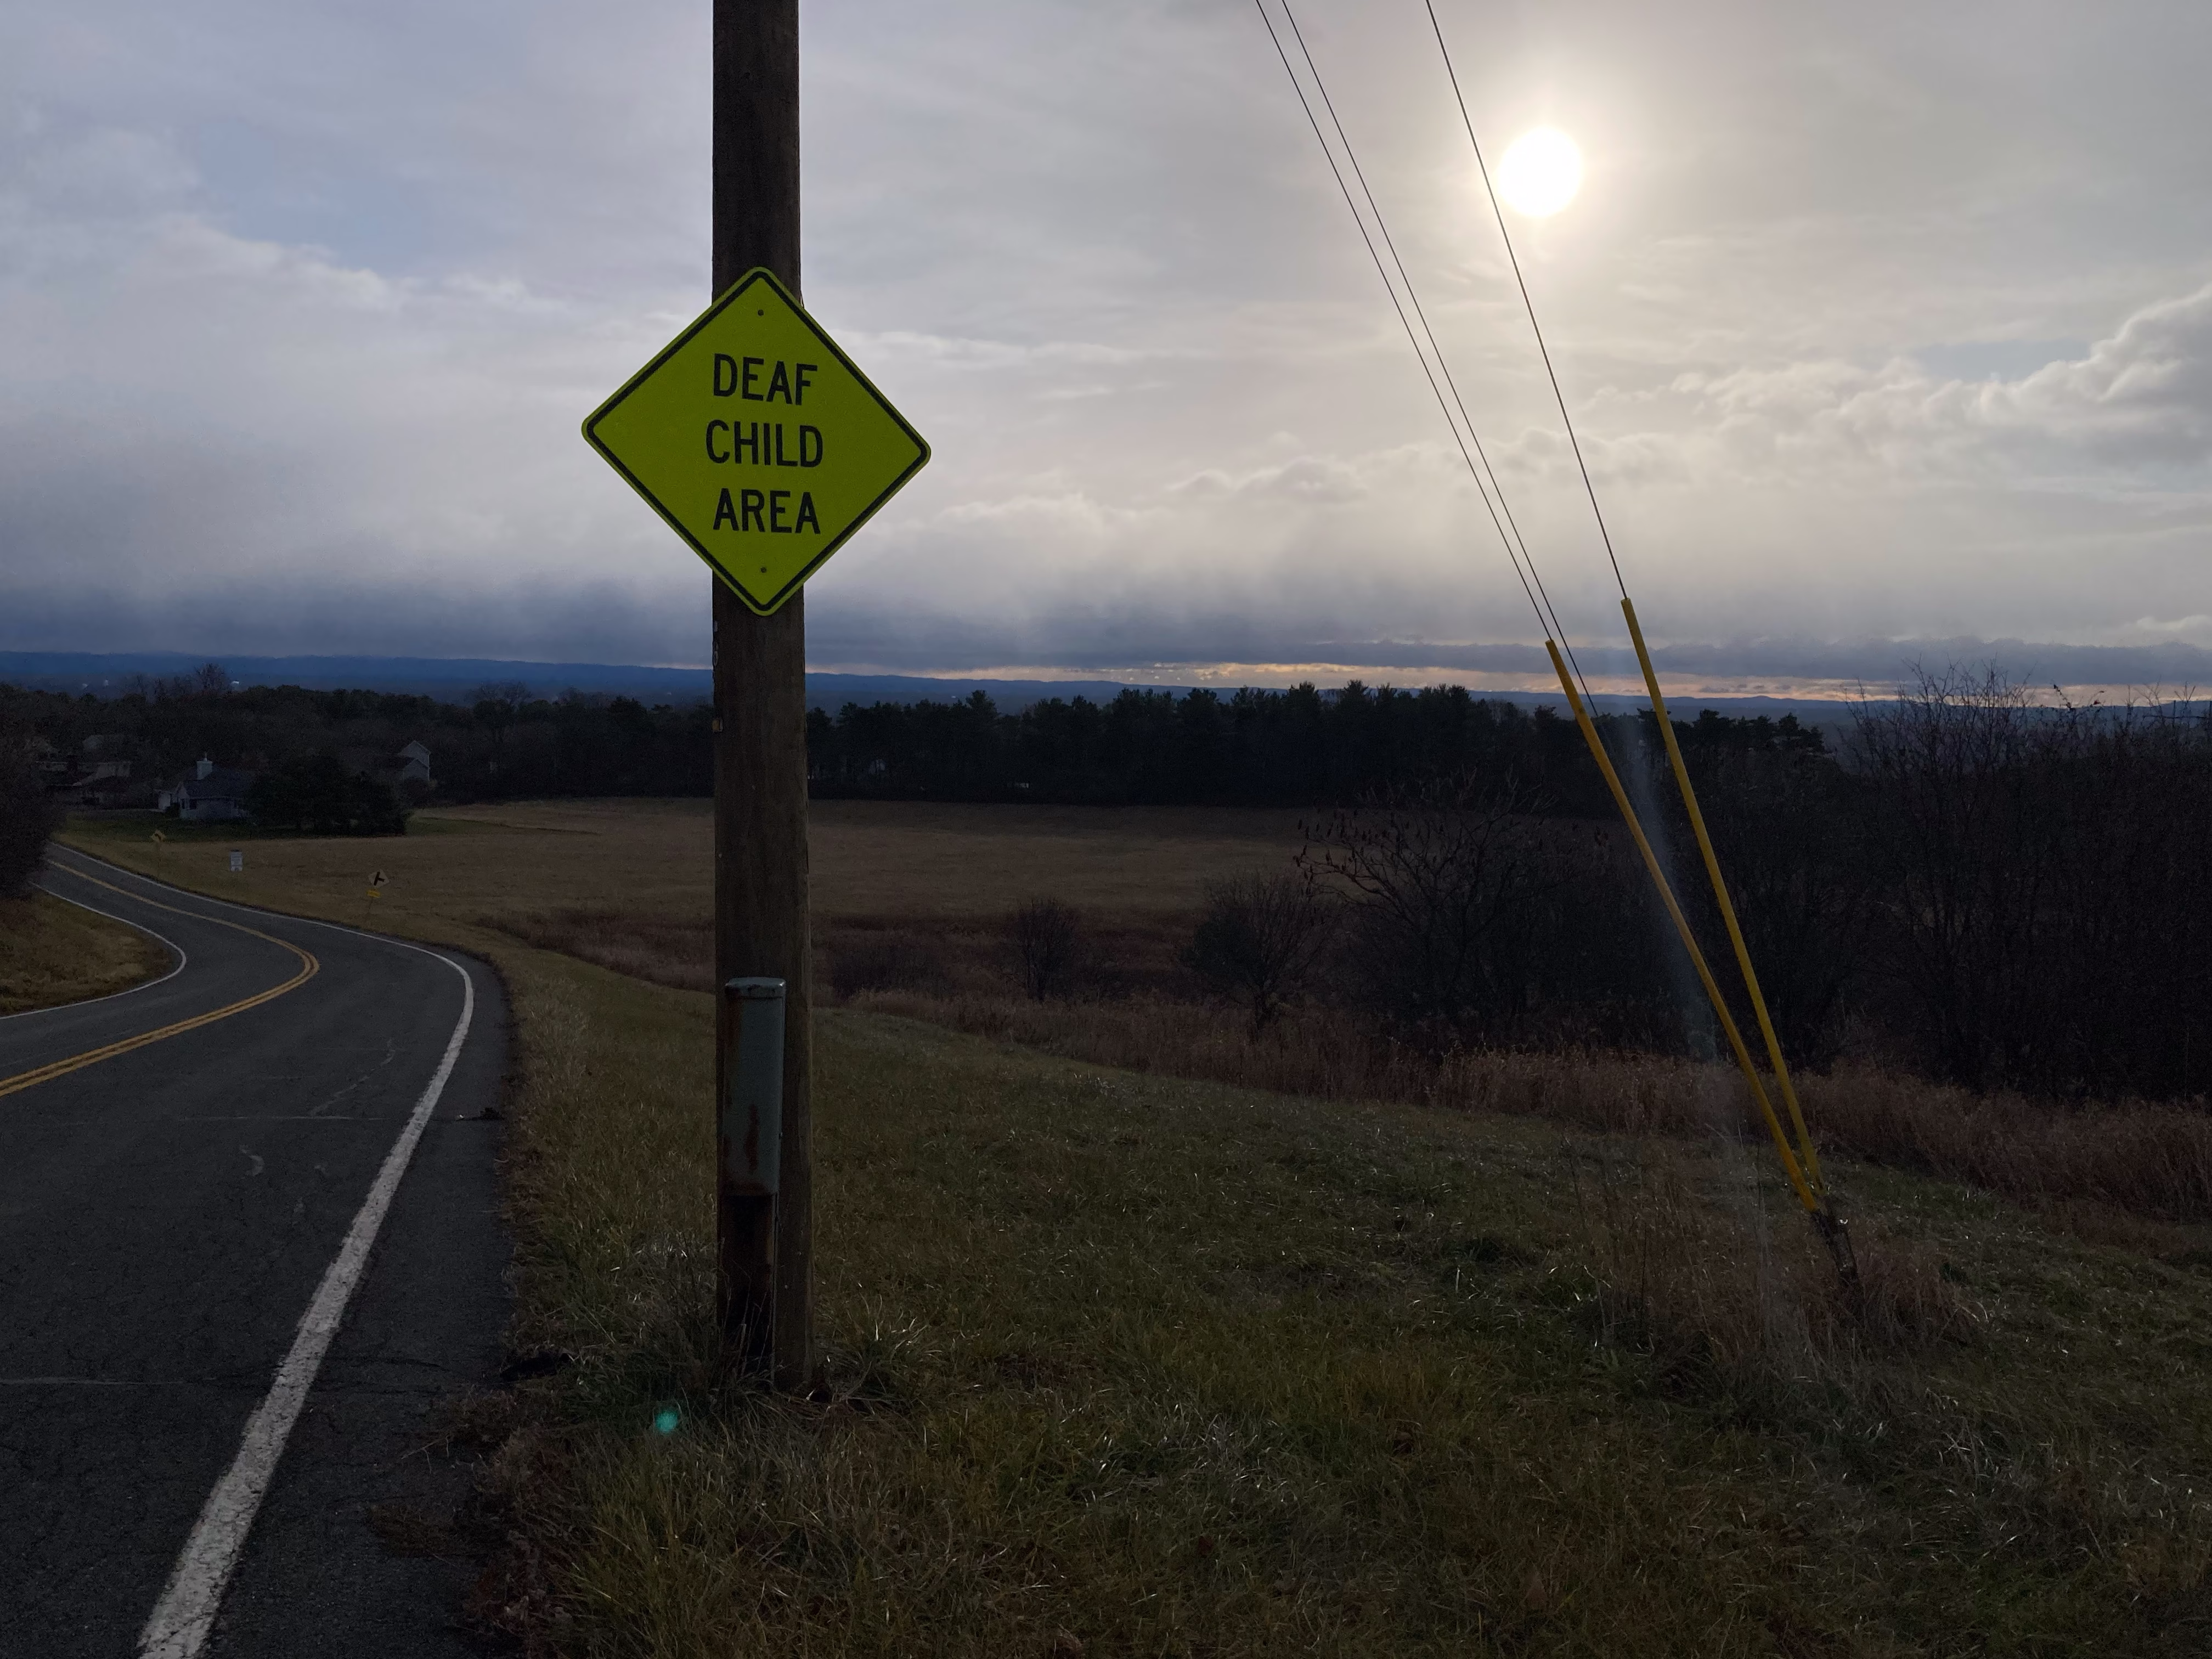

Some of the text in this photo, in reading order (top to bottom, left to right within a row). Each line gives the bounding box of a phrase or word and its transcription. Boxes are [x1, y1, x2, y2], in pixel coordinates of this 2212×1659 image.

[713, 353, 818, 406] DEAF
[706, 419, 823, 468] CHILD
[713, 488, 821, 534] AREA
